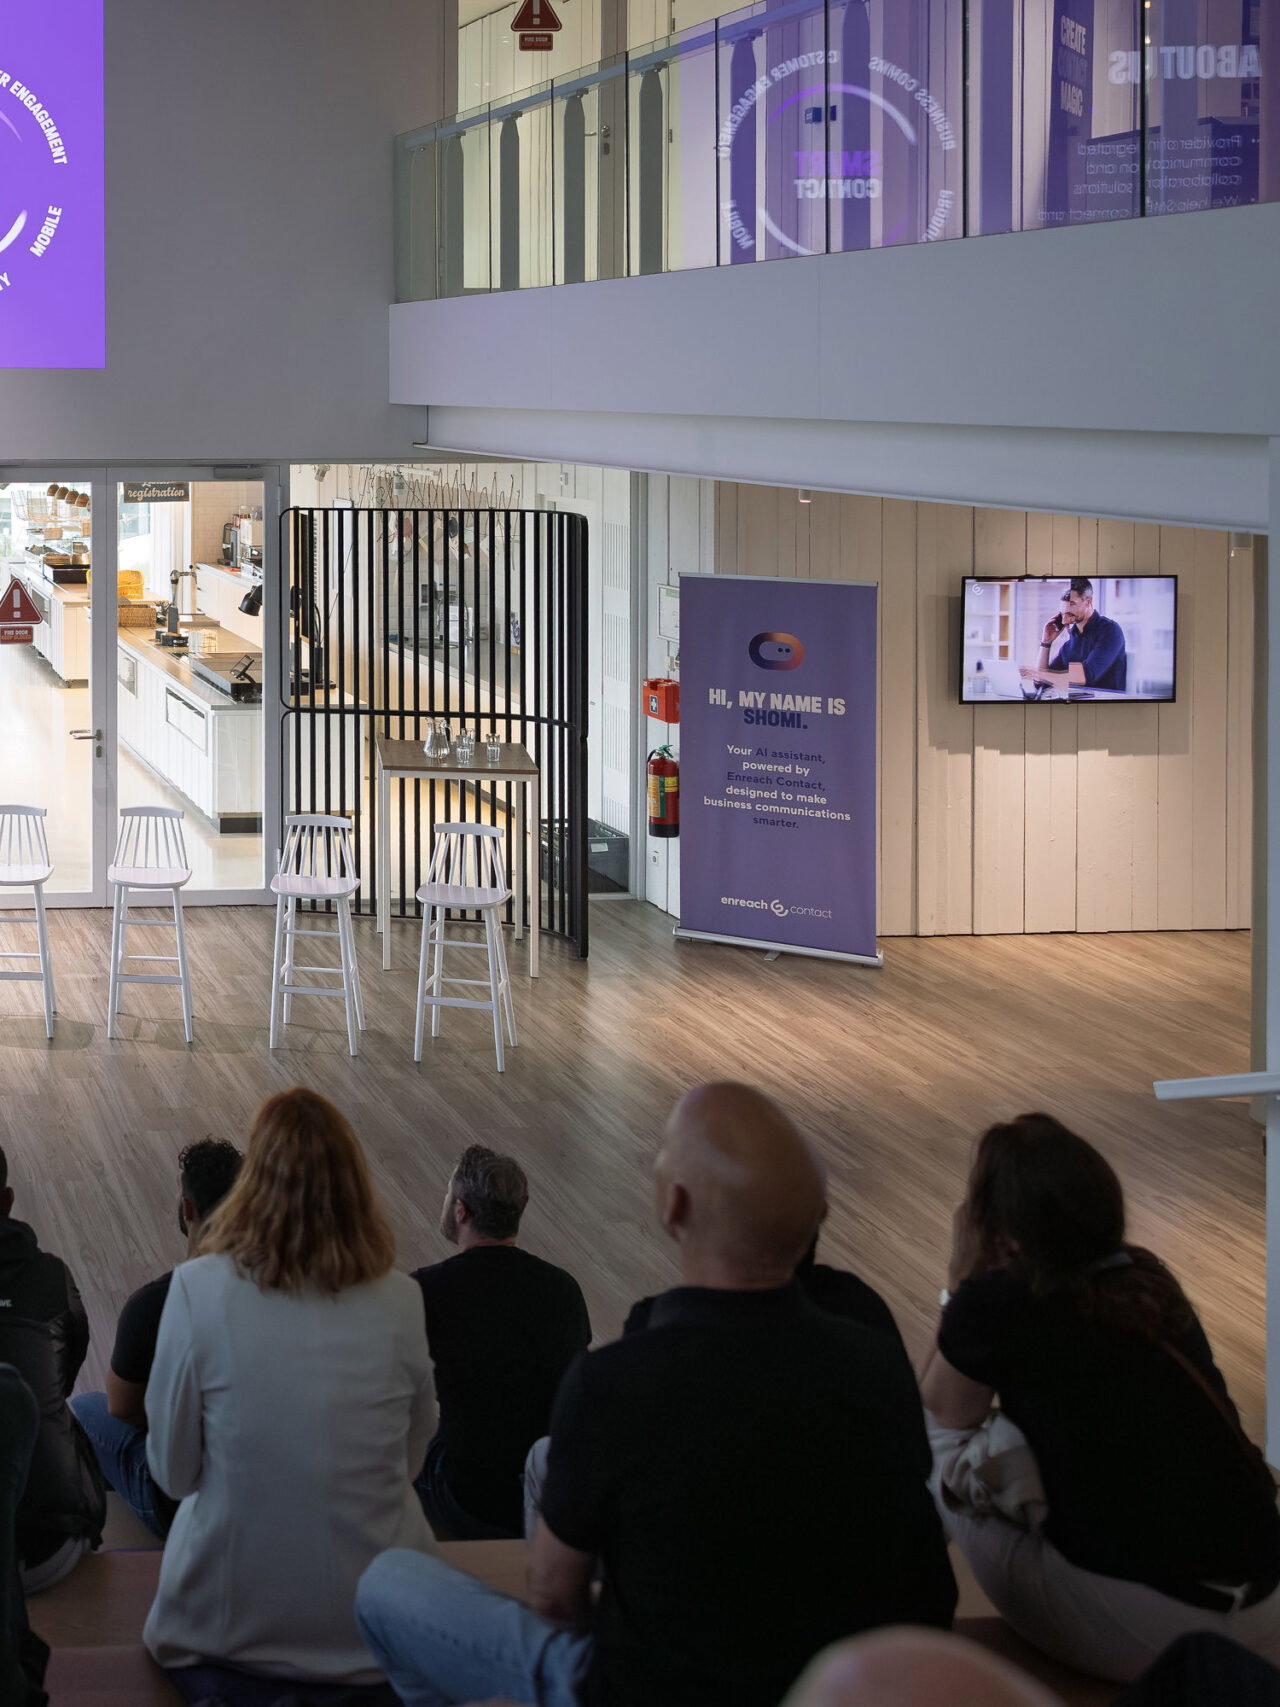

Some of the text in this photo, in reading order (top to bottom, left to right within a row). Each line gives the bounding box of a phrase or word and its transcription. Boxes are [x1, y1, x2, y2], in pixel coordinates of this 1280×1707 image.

[1061, 15, 1086, 55] CREATE
[1060, 81, 1084, 116] MAGIC
[8, 80, 68, 165] ENGAGEMENT
[29, 205, 62, 257] MOBILE
[128, 487, 184, 501] registration
[709, 688, 846, 715] HI, MY NAME IS
[743, 709, 808, 729] SHOMI.
[726, 745, 826, 764] Your AI assistant,
[742, 761, 810, 776] powered by
[727, 772, 826, 791] Enreach Contact,
[726, 785, 827, 805] designed to make
[703, 796, 851, 821] business communications
[752, 816, 799, 829] smarter.
[721, 896, 832, 919] enreach contact
